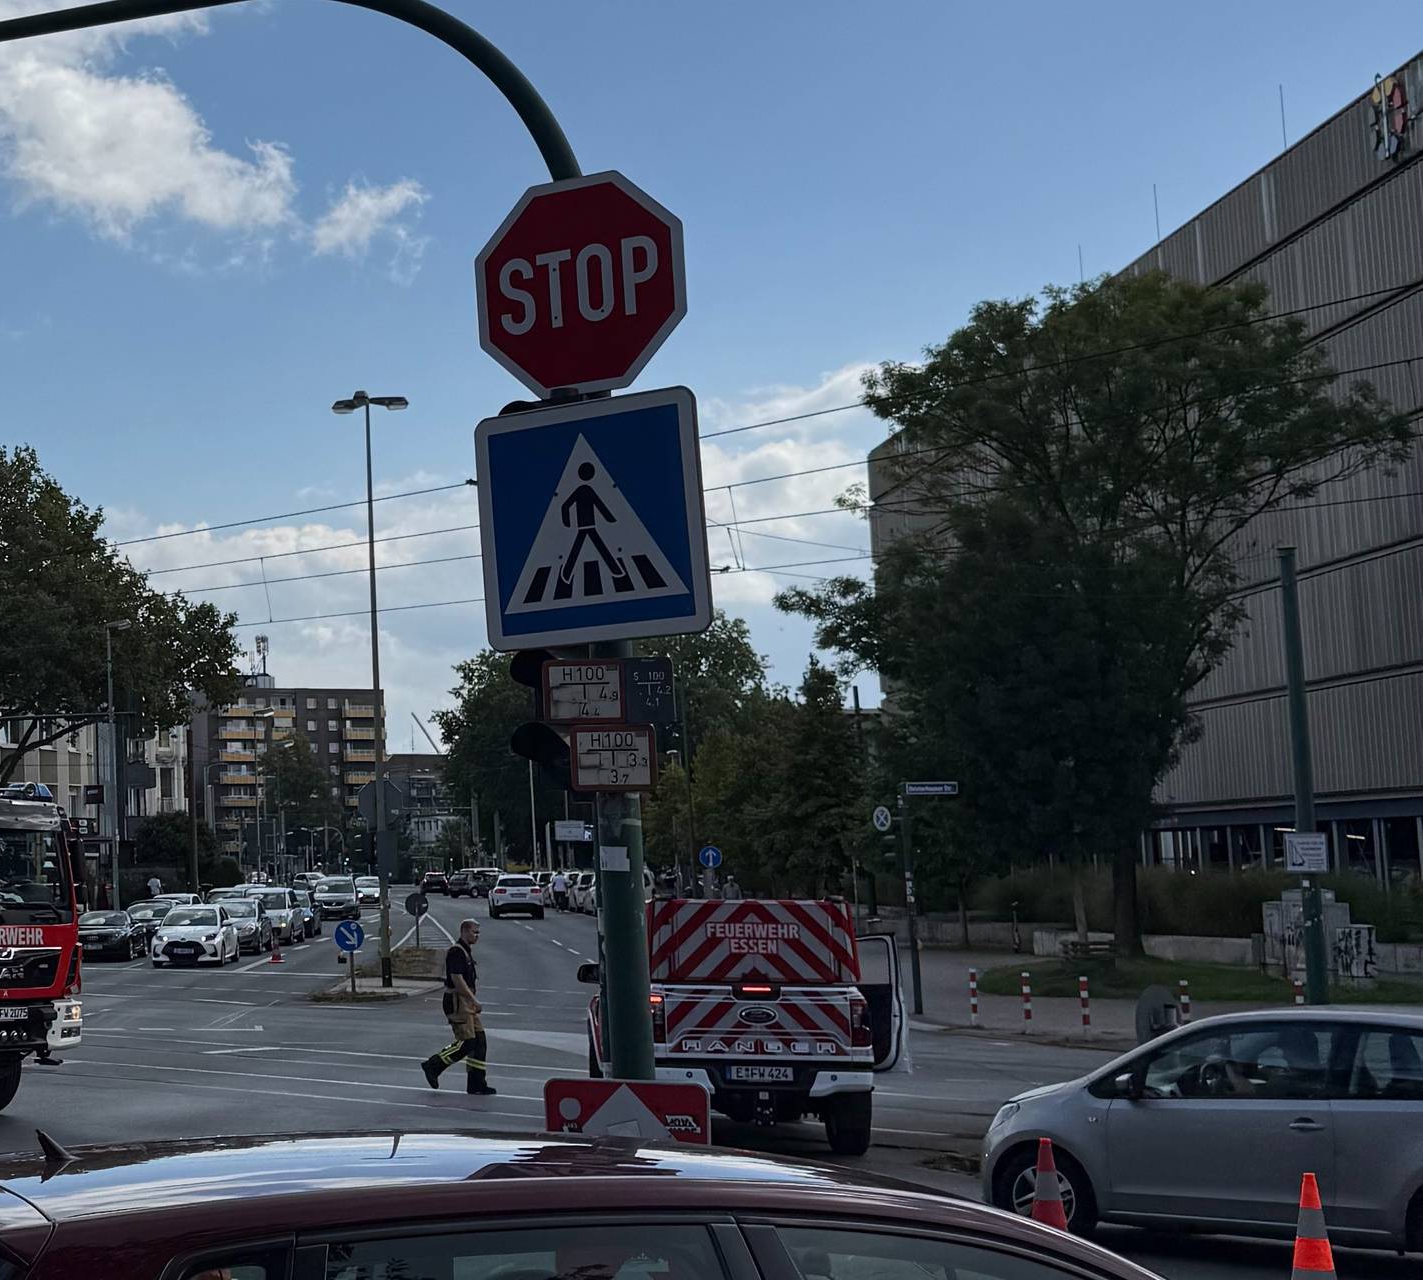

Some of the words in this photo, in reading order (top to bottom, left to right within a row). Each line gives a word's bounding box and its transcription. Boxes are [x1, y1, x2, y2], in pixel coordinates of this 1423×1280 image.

[498, 235, 658, 335] STOP
[633, 671, 639, 681] S
[705, 922, 801, 940] FEUERWEHR
[729, 939, 778, 955] ESSEN
[736, 1067, 744, 1078] E
[751, 1067, 765, 1079] FW
[768, 1068, 788, 1079] 424
